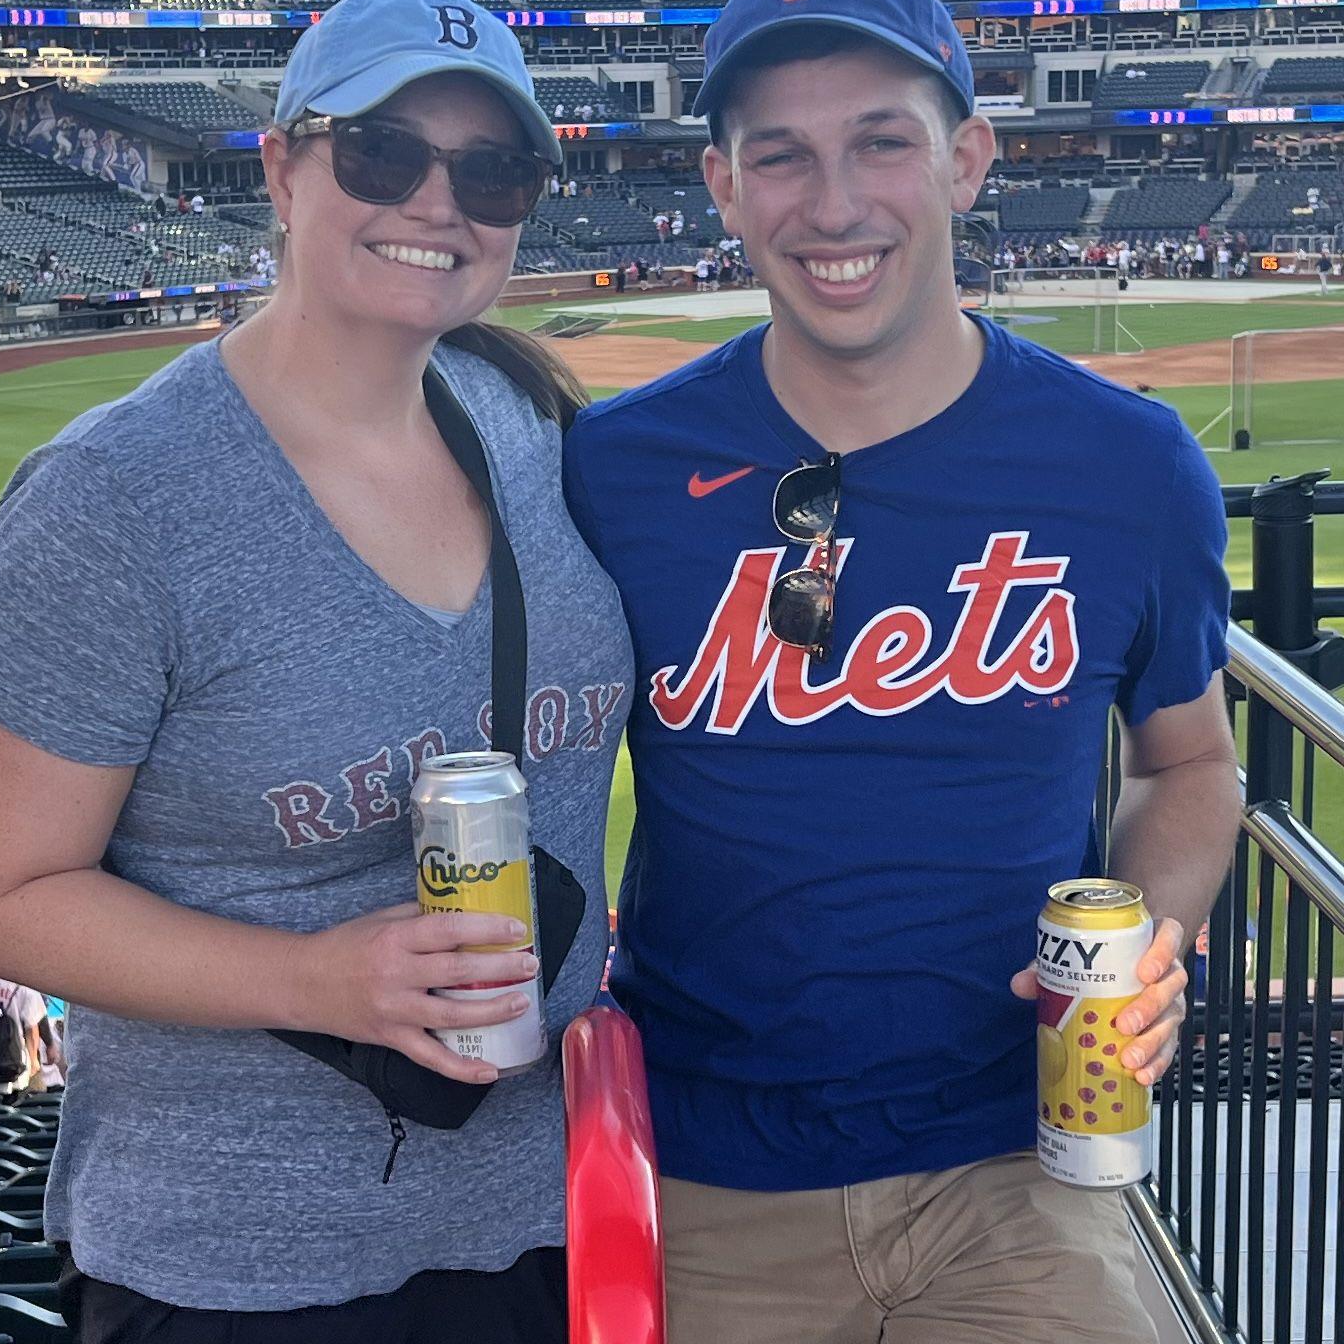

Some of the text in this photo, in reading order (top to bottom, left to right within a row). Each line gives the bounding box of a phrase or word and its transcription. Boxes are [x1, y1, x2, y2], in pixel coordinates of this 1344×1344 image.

[429, 5, 479, 51] B
[649, 530, 1080, 736] Mets
[419, 845, 508, 897] Chico
[1067, 971, 1116, 983] SELTZER
